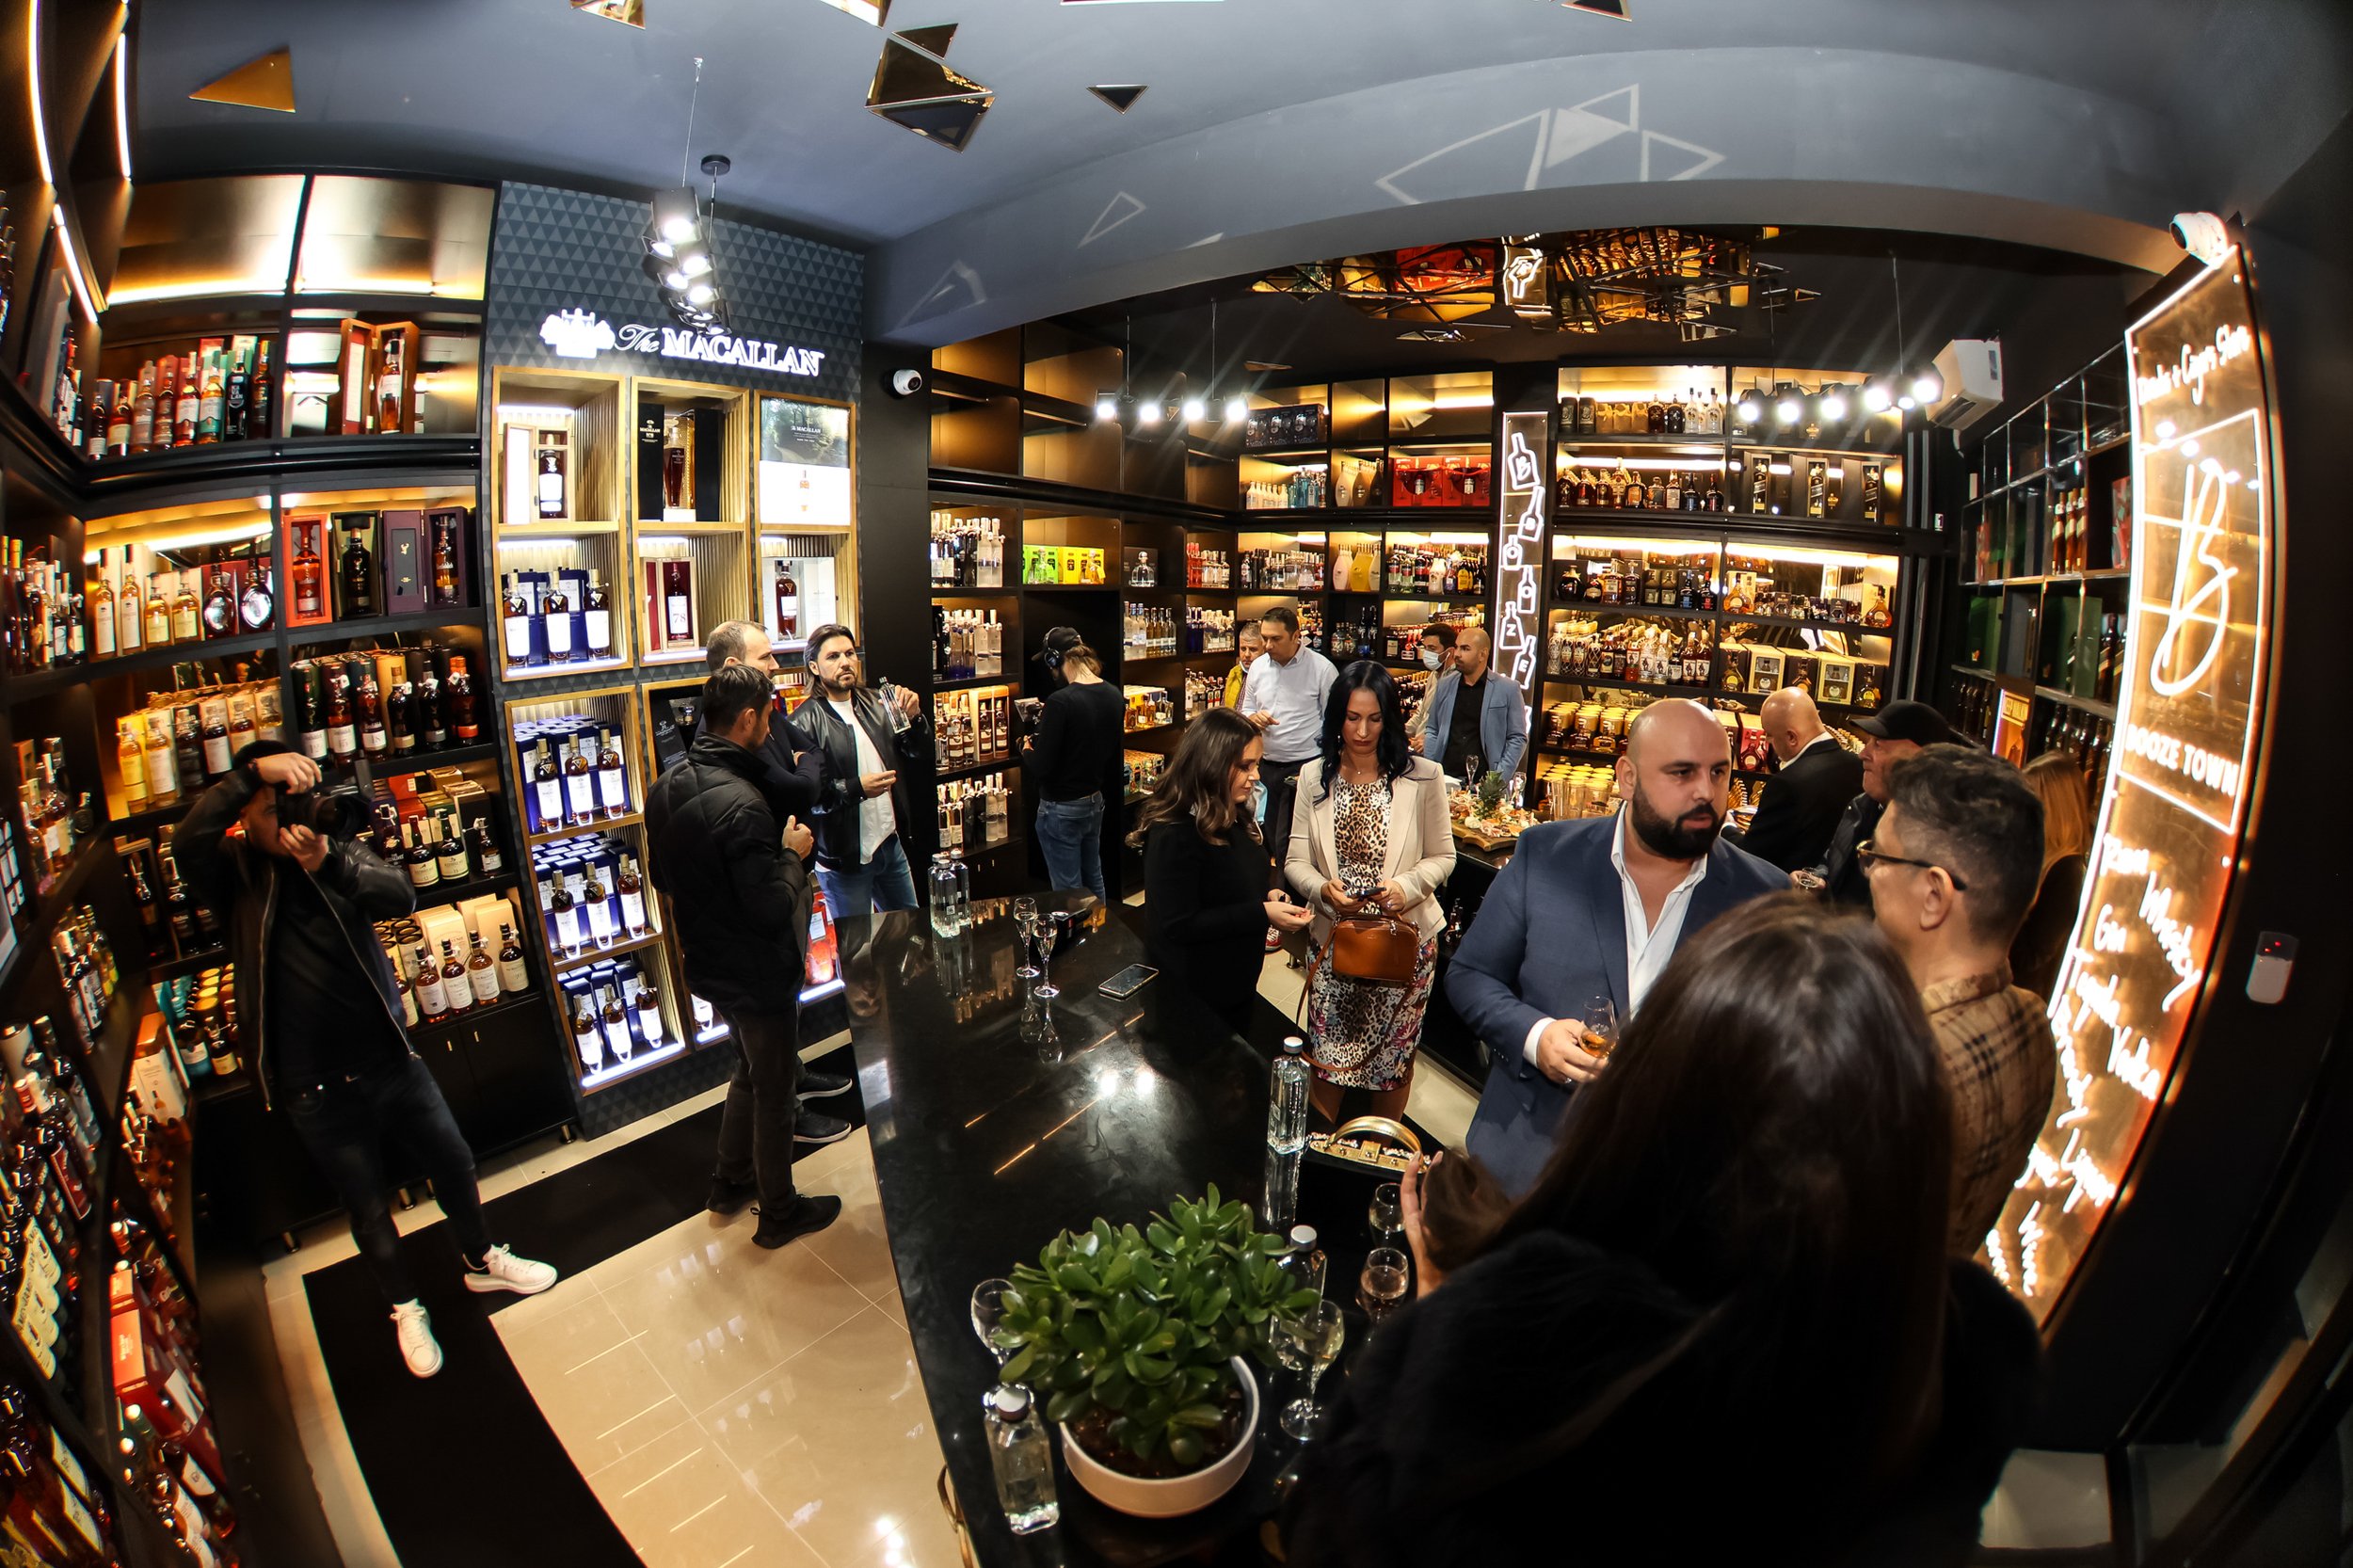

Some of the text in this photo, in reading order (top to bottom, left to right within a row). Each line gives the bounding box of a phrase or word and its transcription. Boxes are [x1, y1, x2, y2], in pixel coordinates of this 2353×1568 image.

[614, 323, 824, 376] The MACALLAN
[672, 613, 686, 623] 78
[2124, 723, 2240, 797] BOOZE TOWN
[2100, 832, 2150, 877] Rum
[2094, 904, 2127, 952] Gin
[2107, 1025, 2160, 1100] Vodka
